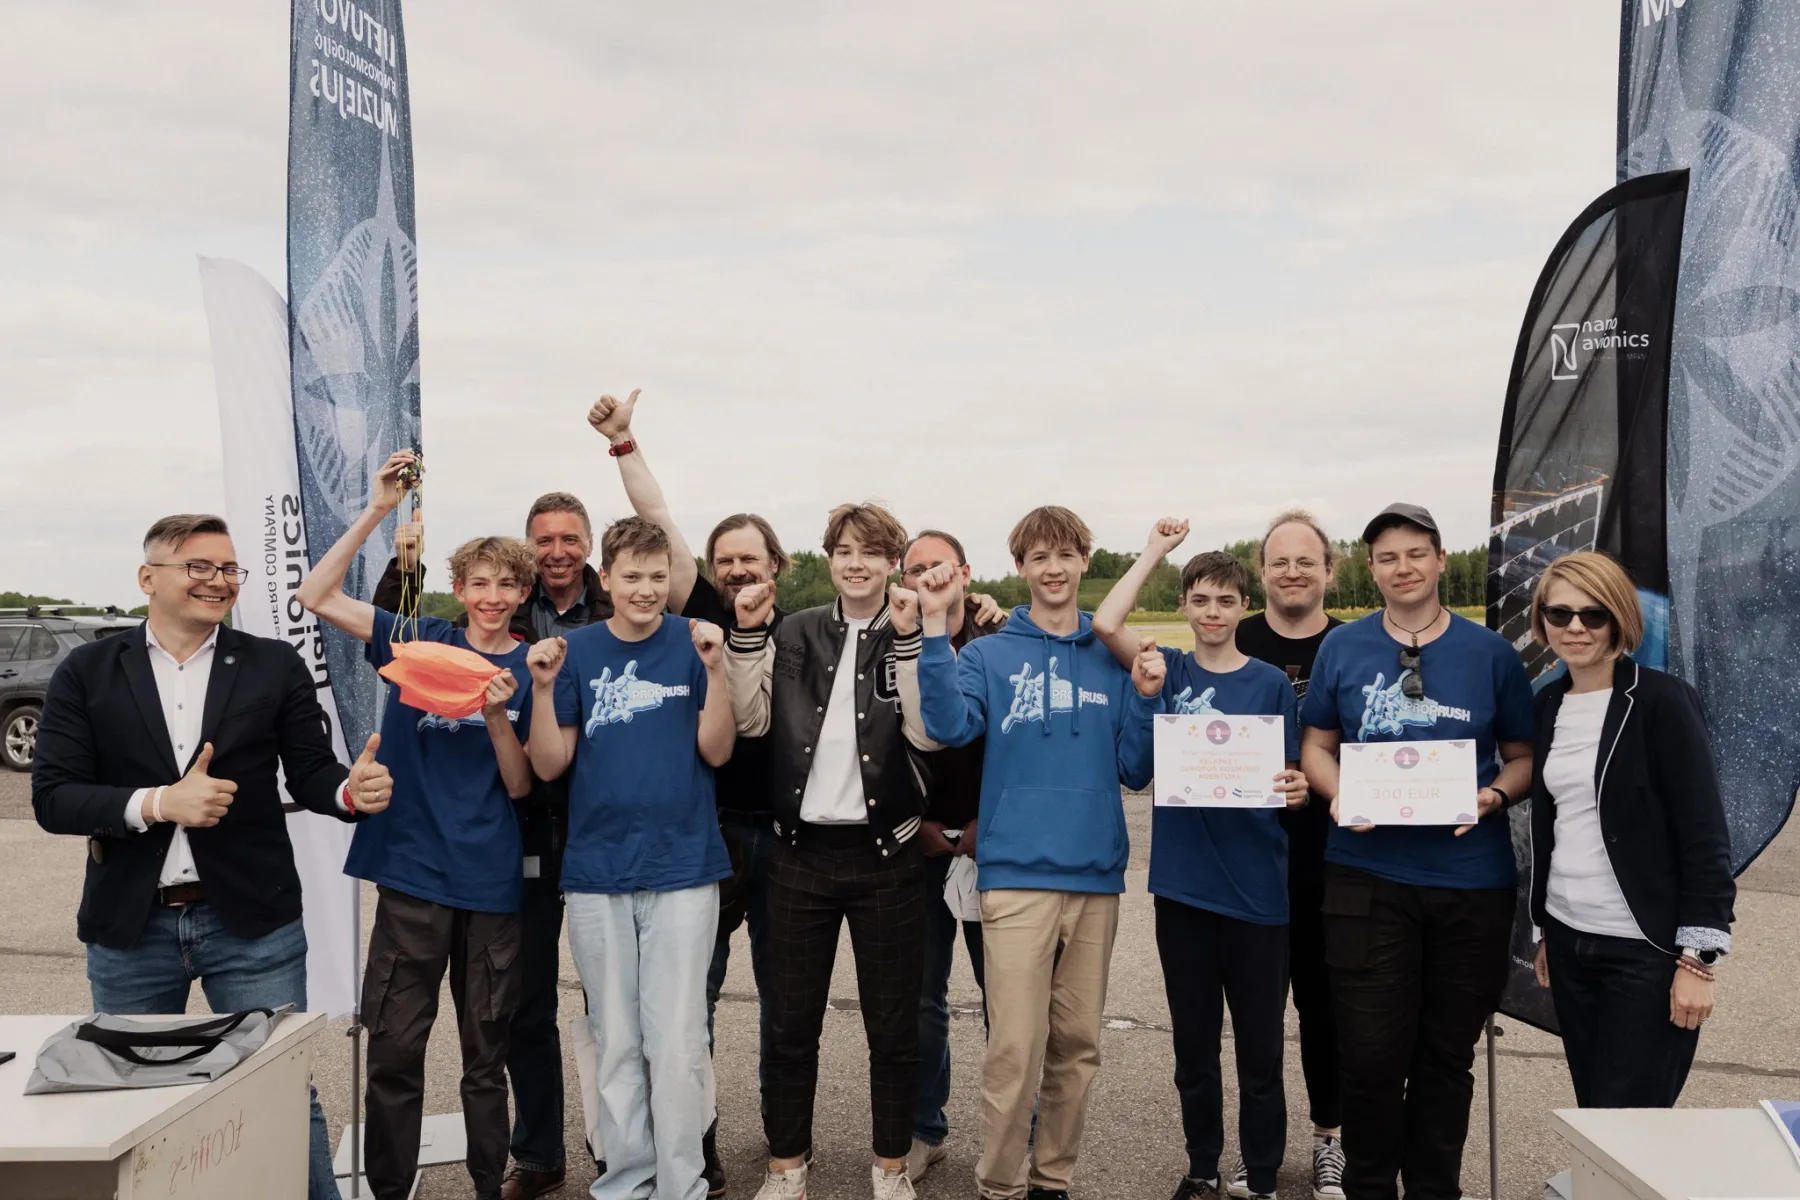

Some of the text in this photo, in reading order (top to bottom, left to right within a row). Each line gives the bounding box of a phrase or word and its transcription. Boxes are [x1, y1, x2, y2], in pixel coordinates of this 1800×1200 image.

[1582, 331, 1650, 351] avionics
[631, 684, 690, 701] PROPRUSH
[1403, 702, 1471, 722] PROPRUSH
[1371, 787, 1440, 800] 300 EUR
